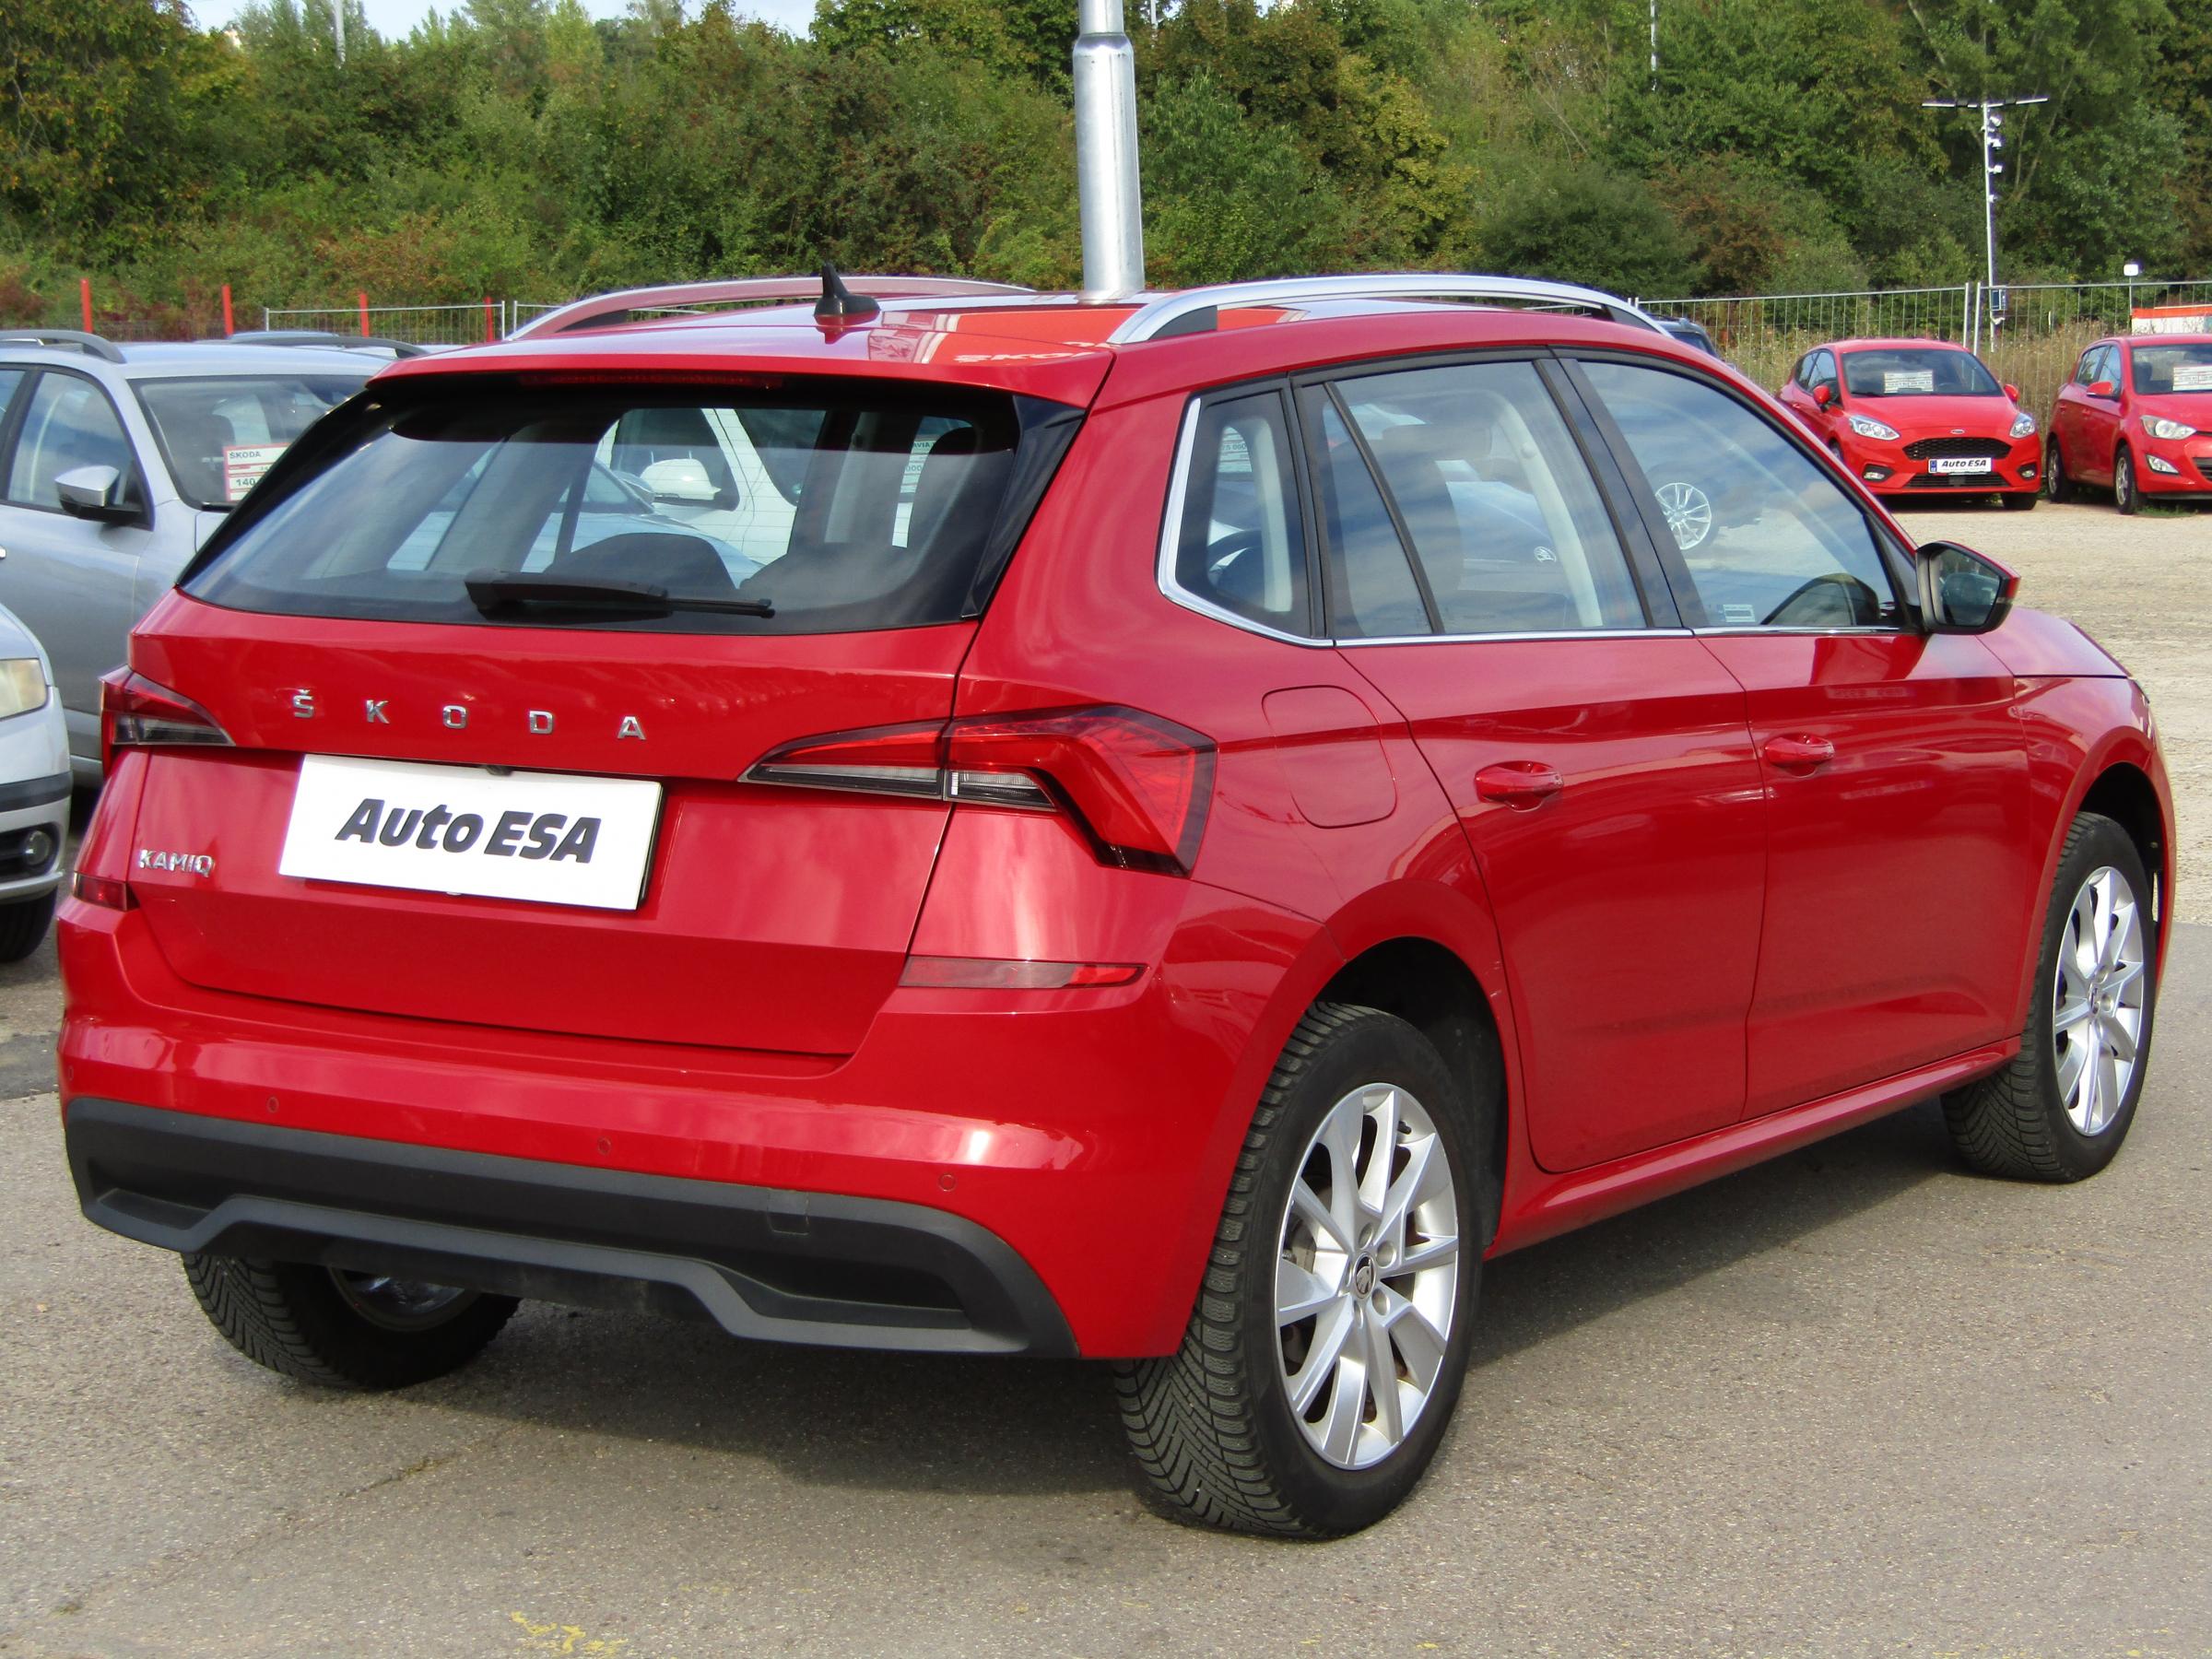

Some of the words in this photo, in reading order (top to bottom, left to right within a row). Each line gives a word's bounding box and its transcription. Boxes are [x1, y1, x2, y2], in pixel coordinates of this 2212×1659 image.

[292, 688, 646, 741] ŠKODA
[334, 798, 484, 853] Auto
[484, 810, 602, 864] ESA
[139, 849, 214, 878] KAMIQ
